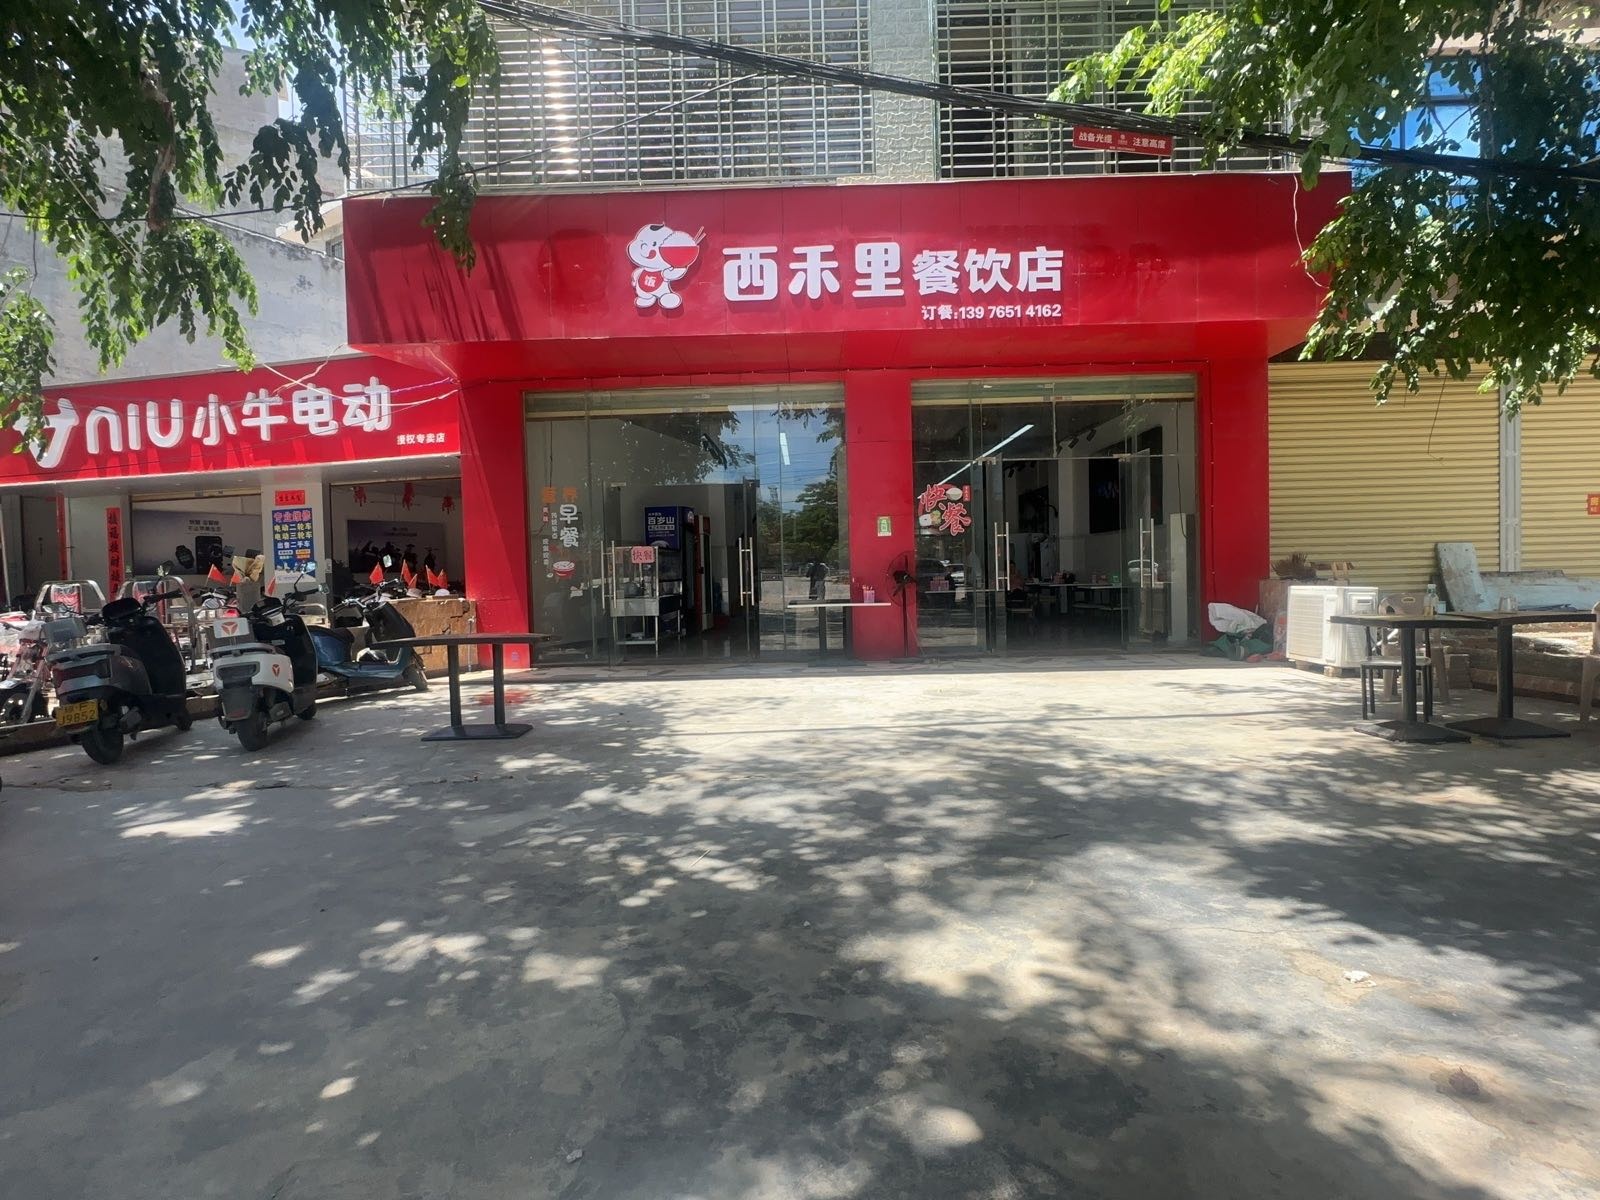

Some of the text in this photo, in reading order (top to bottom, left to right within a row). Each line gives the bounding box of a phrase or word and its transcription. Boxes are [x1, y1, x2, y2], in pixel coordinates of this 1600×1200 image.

[1078, 131, 1113, 144] 战备光缆
[1132, 137, 1166, 149] 注意高度
[722, 242, 1065, 301] 西禾里餐饮店
[987, 304, 1022, 319] 7651
[1025, 303, 1062, 318] 4162
[192, 376, 392, 446] 小牛电动
[397, 432, 445, 445] 授权专卖店
[560, 504, 579, 547] 早餐
[648, 516, 675, 525] 百岁山
